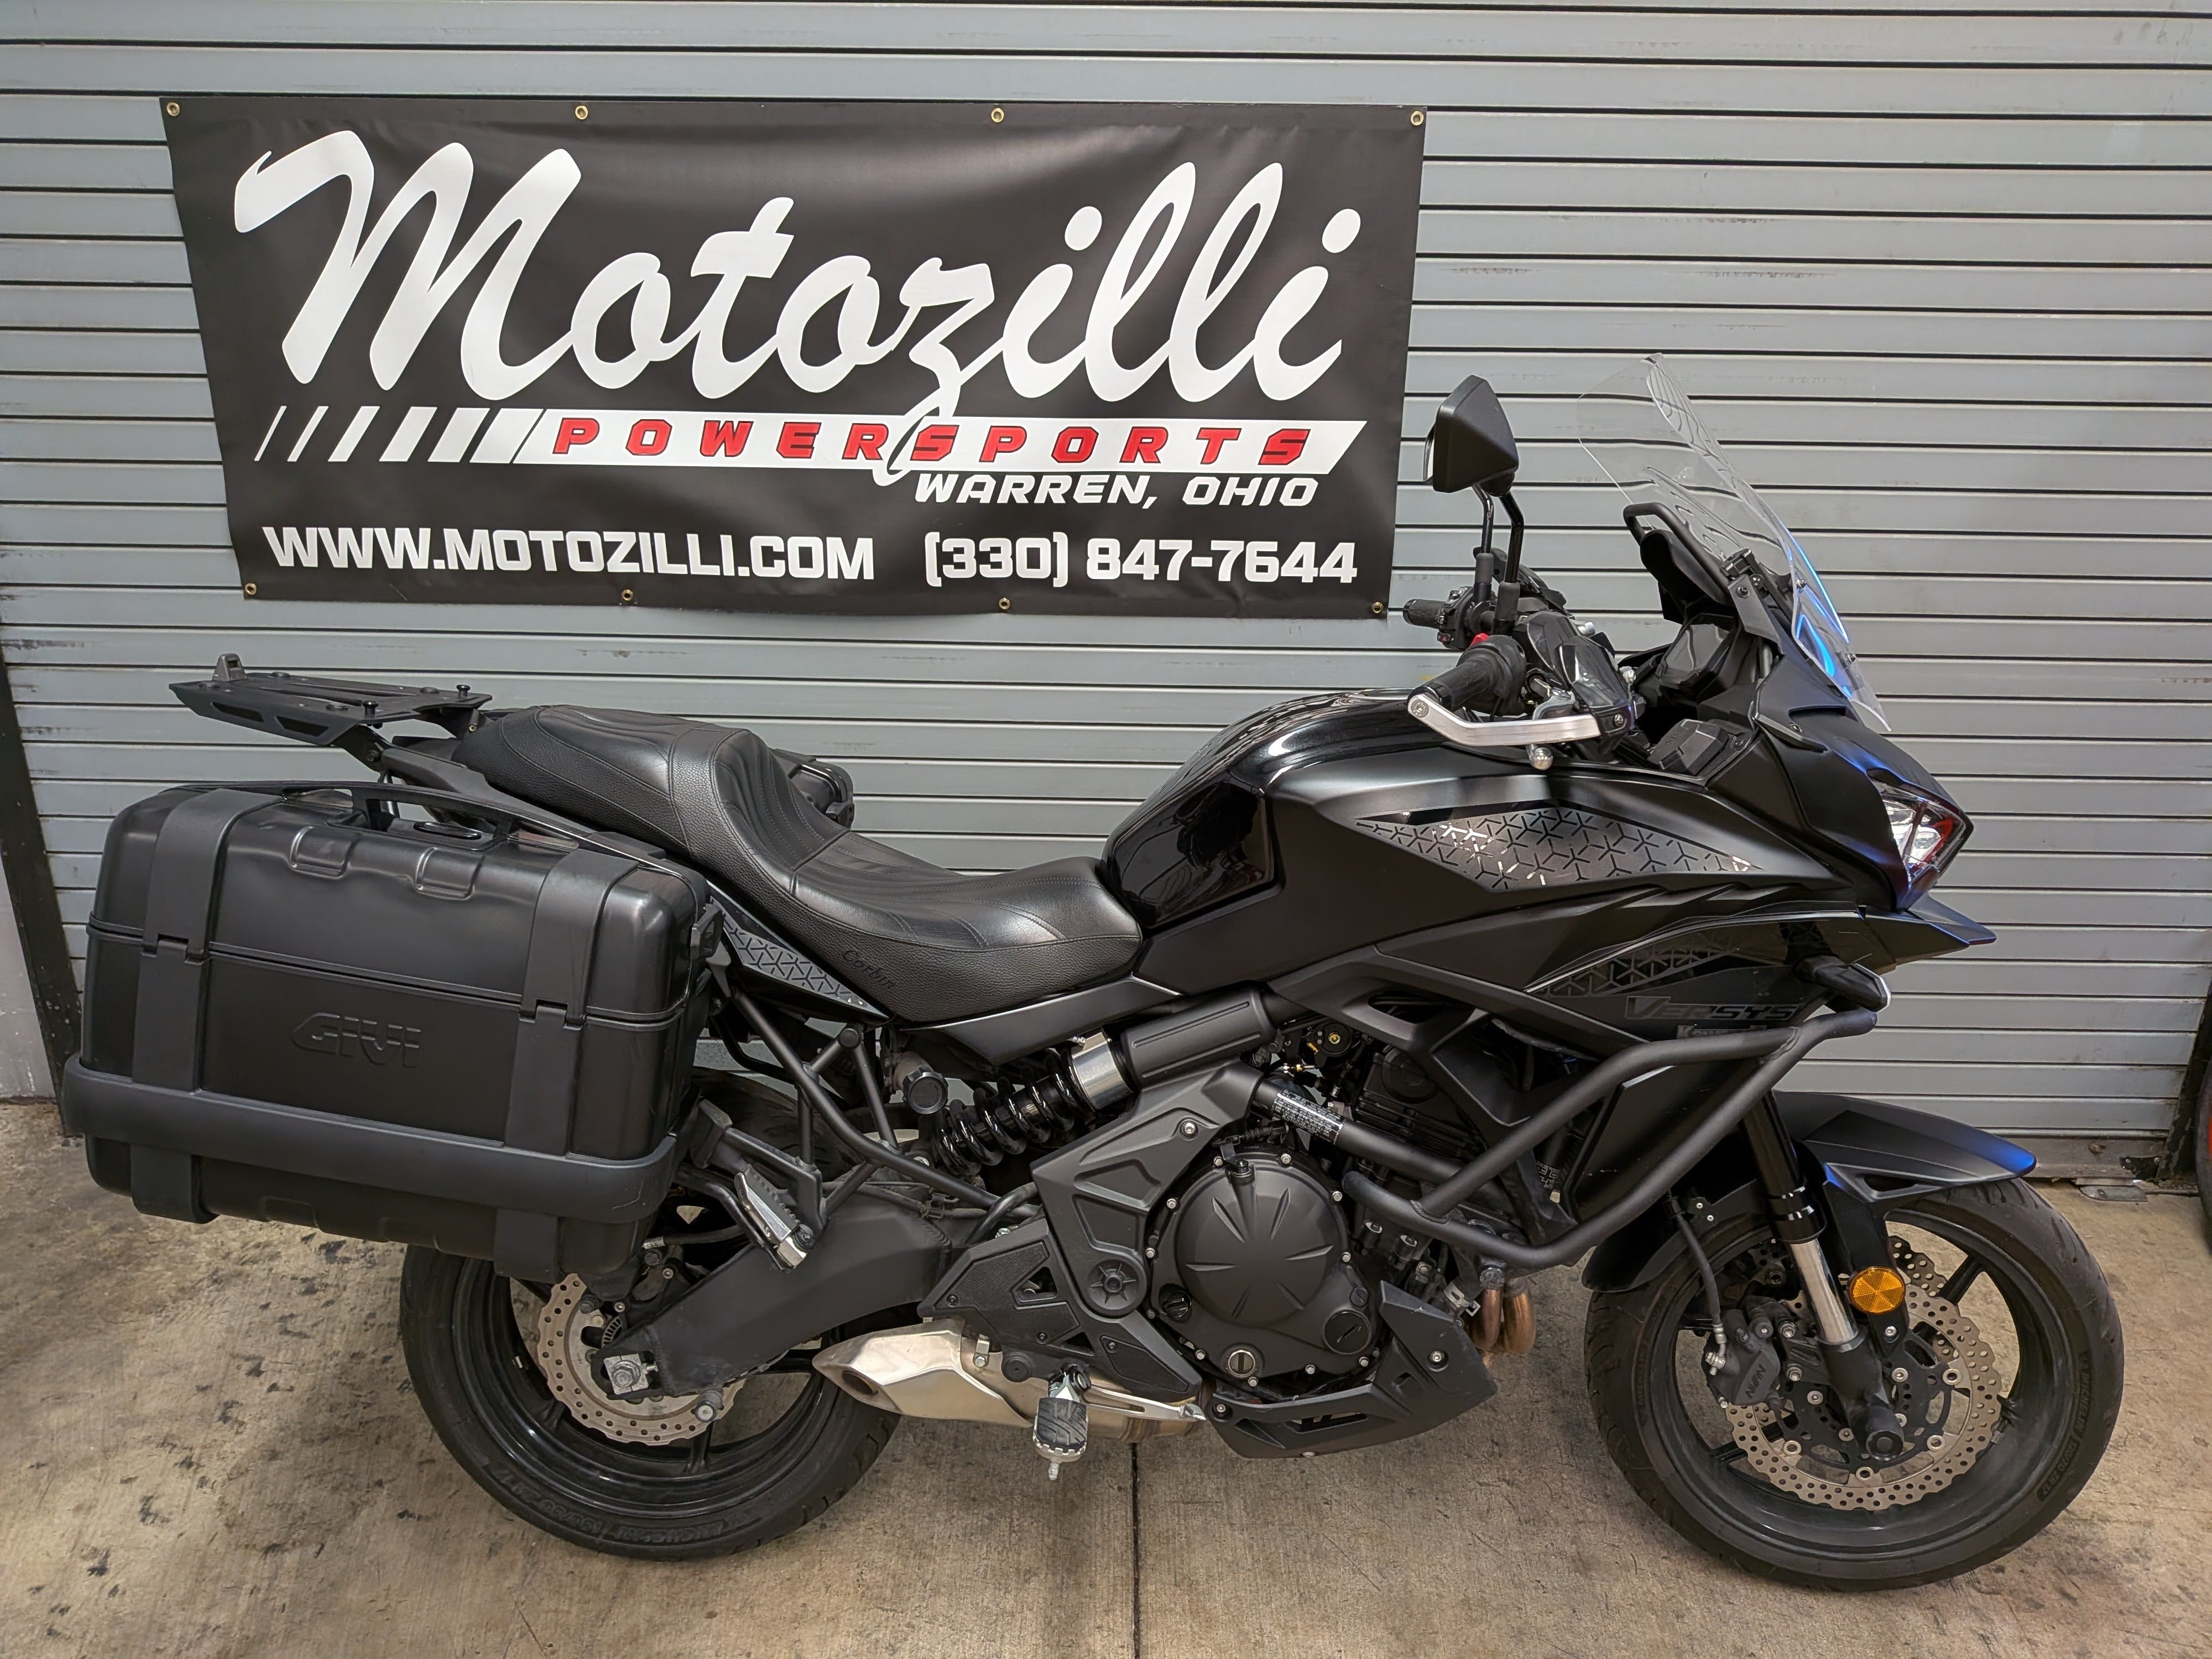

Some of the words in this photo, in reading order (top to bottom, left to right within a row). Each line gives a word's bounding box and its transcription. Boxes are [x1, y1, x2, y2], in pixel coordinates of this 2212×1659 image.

[234, 131, 1361, 486] Motozilli
[553, 418, 1311, 466] POWERSPORTS
[915, 473, 1156, 509] WARREN,
[1182, 477, 1319, 506] OHIO
[262, 527, 874, 580] WWW.MOTOZILLI.COM
[925, 532, 1068, 587] (330)
[1087, 538, 1358, 583] 847-7644
[842, 950, 895, 989] Corbin
[291, 1013, 421, 1068] GIVI
